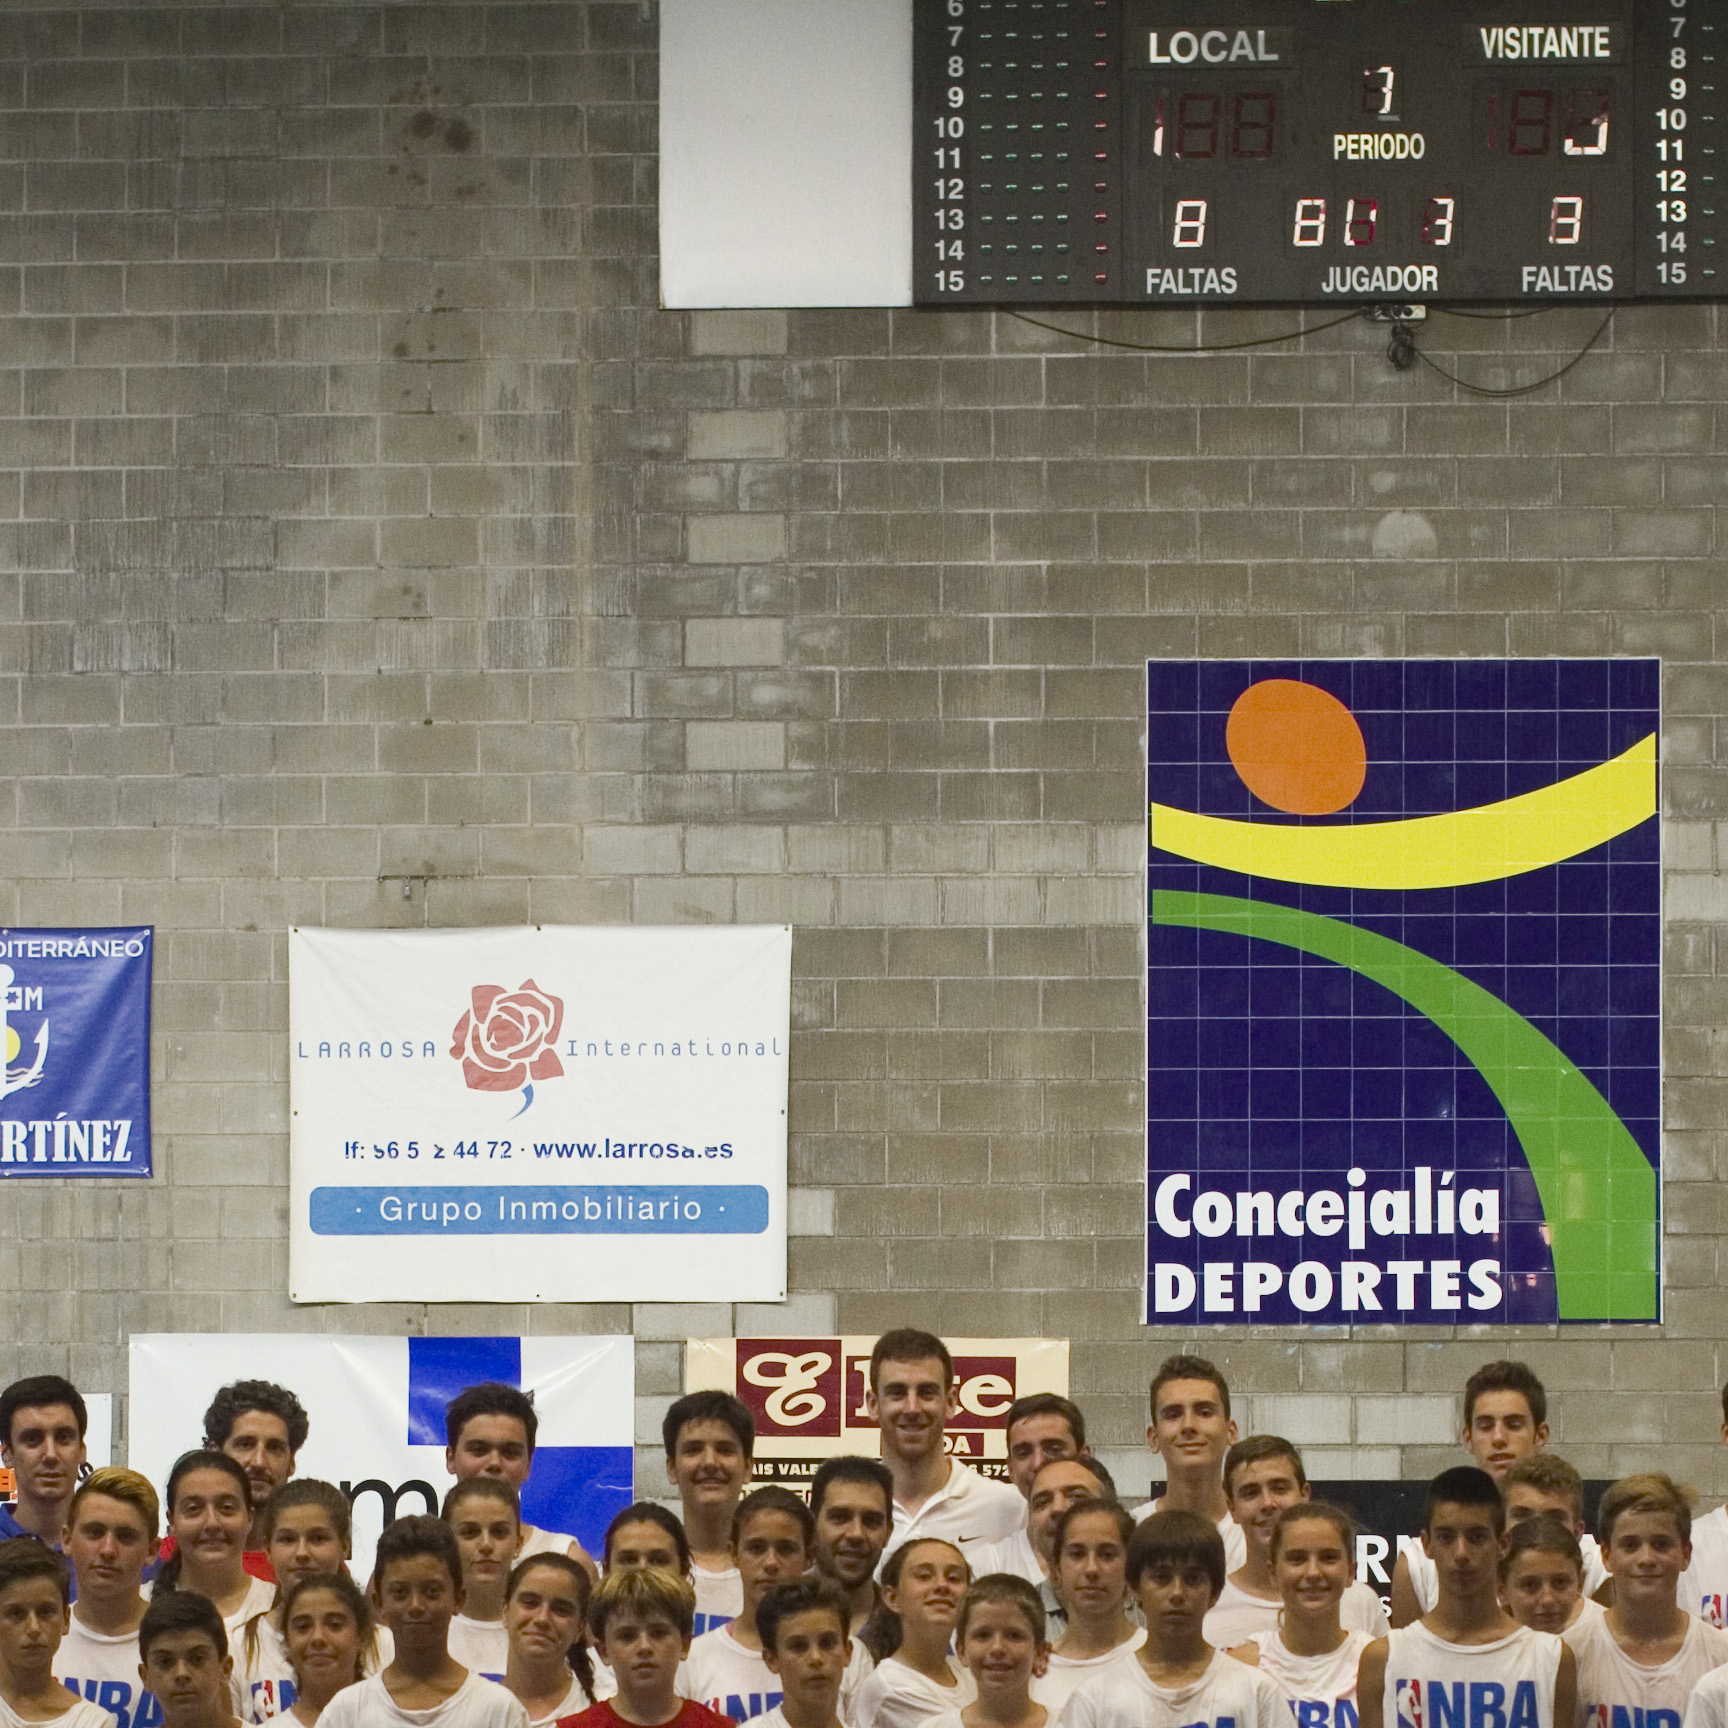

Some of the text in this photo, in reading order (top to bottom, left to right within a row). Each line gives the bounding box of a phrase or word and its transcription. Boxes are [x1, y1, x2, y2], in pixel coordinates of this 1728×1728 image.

[948, 26, 964, 47] 7
[1670, 17, 1686, 39] 7
[1149, 30, 1279, 64] LOCAL
[1480, 27, 1610, 59] VISITANTE
[948, 55, 964, 78] 8
[1670, 47, 1686, 69] 8
[948, 86, 964, 108] 9
[1669, 78, 1686, 100] 9
[934, 116, 964, 139] 10
[1656, 109, 1687, 130] 10
[934, 147, 962, 169] 11
[1334, 133, 1425, 161] PERIODO
[1656, 139, 1684, 161] 11
[934, 178, 964, 200] 12
[1656, 170, 1687, 192] 12
[934, 208, 964, 231] 13
[1656, 201, 1687, 222] 13
[934, 239, 964, 261] 14
[1656, 231, 1687, 253] 14
[934, 270, 964, 292] 15
[1146, 267, 1237, 294] FALTAS
[1322, 265, 1438, 293] JUGADOR
[1522, 265, 1614, 293] FALTAS
[1656, 262, 1687, 284] 15
[24, 987, 43, 1011] M
[299, 1041, 436, 1058] LARROSA
[567, 1038, 782, 1057] International
[533, 1138, 733, 1159] www.larrosa.es
[380, 1195, 702, 1226] Grupo Inmobiliario
[1155, 1166, 1500, 1249] Concejalía
[1155, 1259, 1502, 1312] DEPORTES
